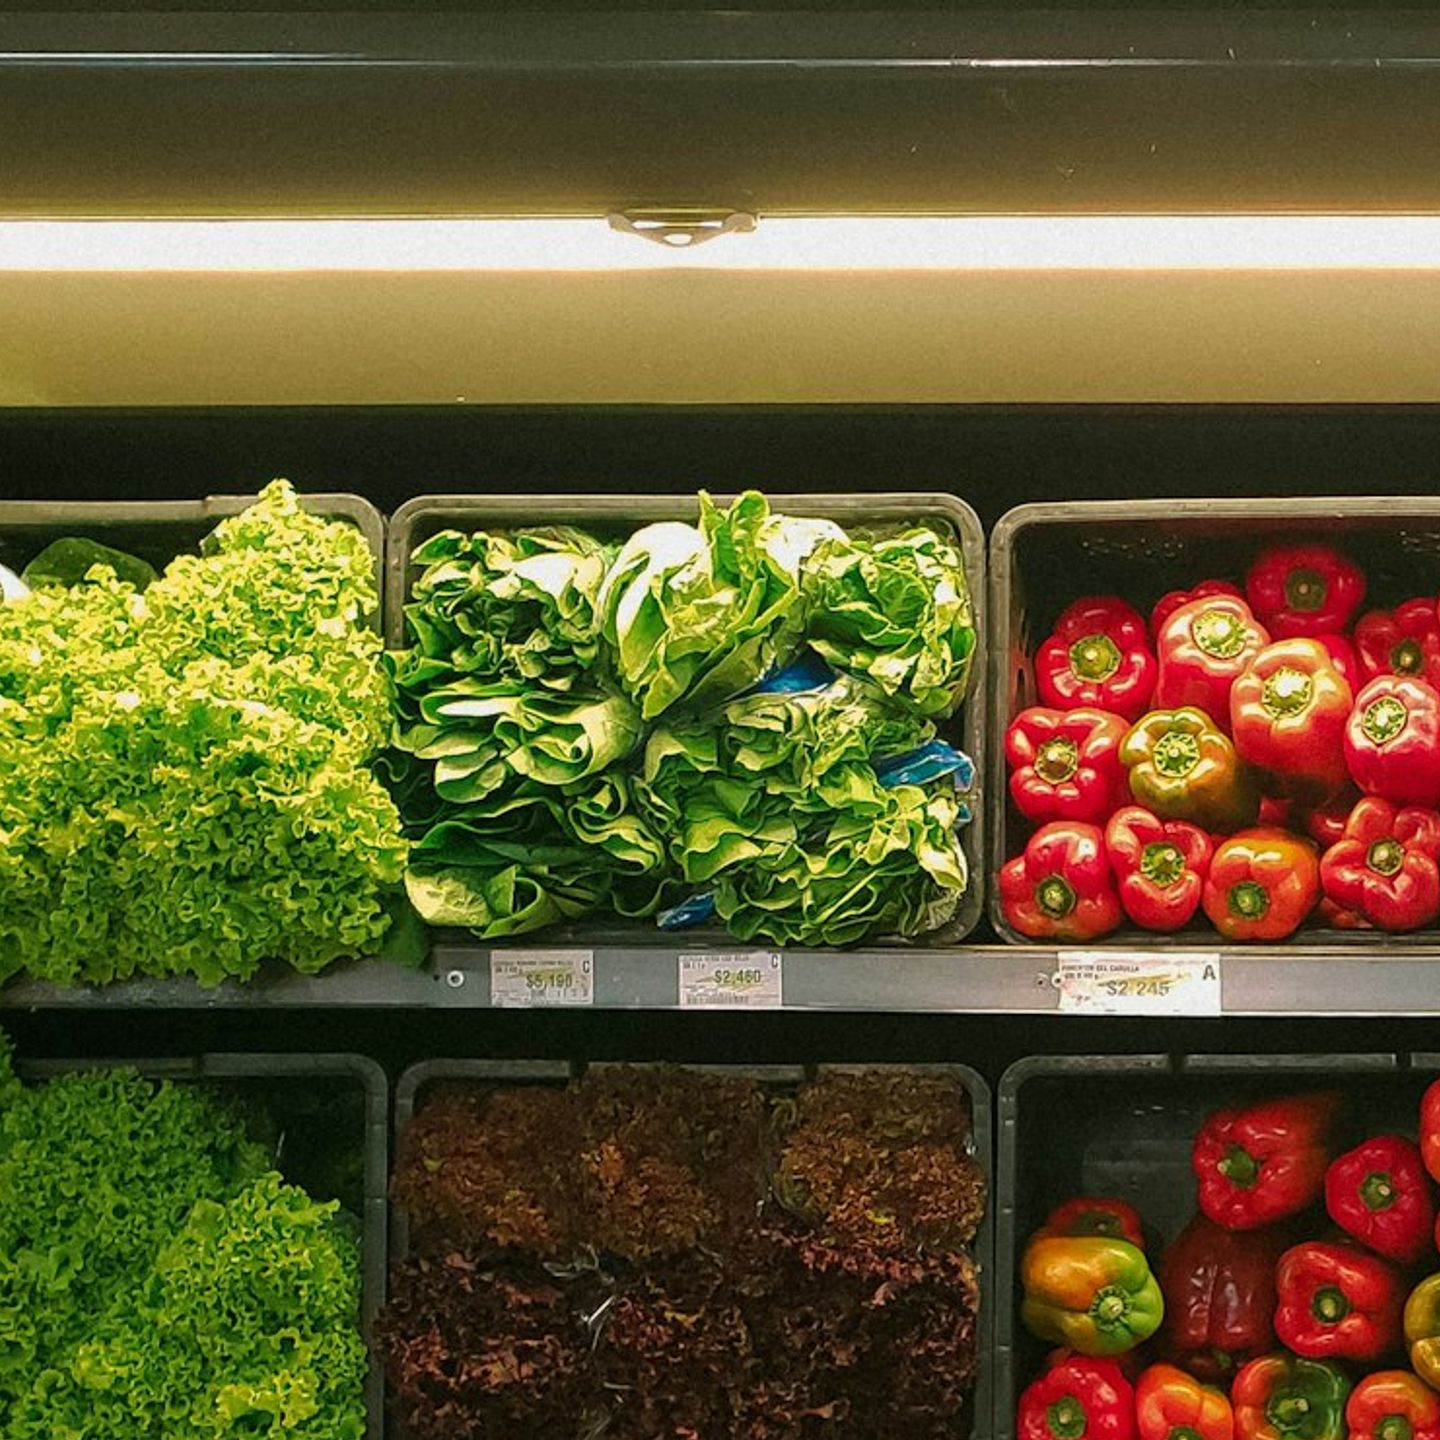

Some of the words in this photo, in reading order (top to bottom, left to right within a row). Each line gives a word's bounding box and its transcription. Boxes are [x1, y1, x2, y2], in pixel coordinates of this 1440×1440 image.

[582, 960, 590, 974] C
[771, 954, 778, 969] C
[1203, 964, 1216, 980] A
